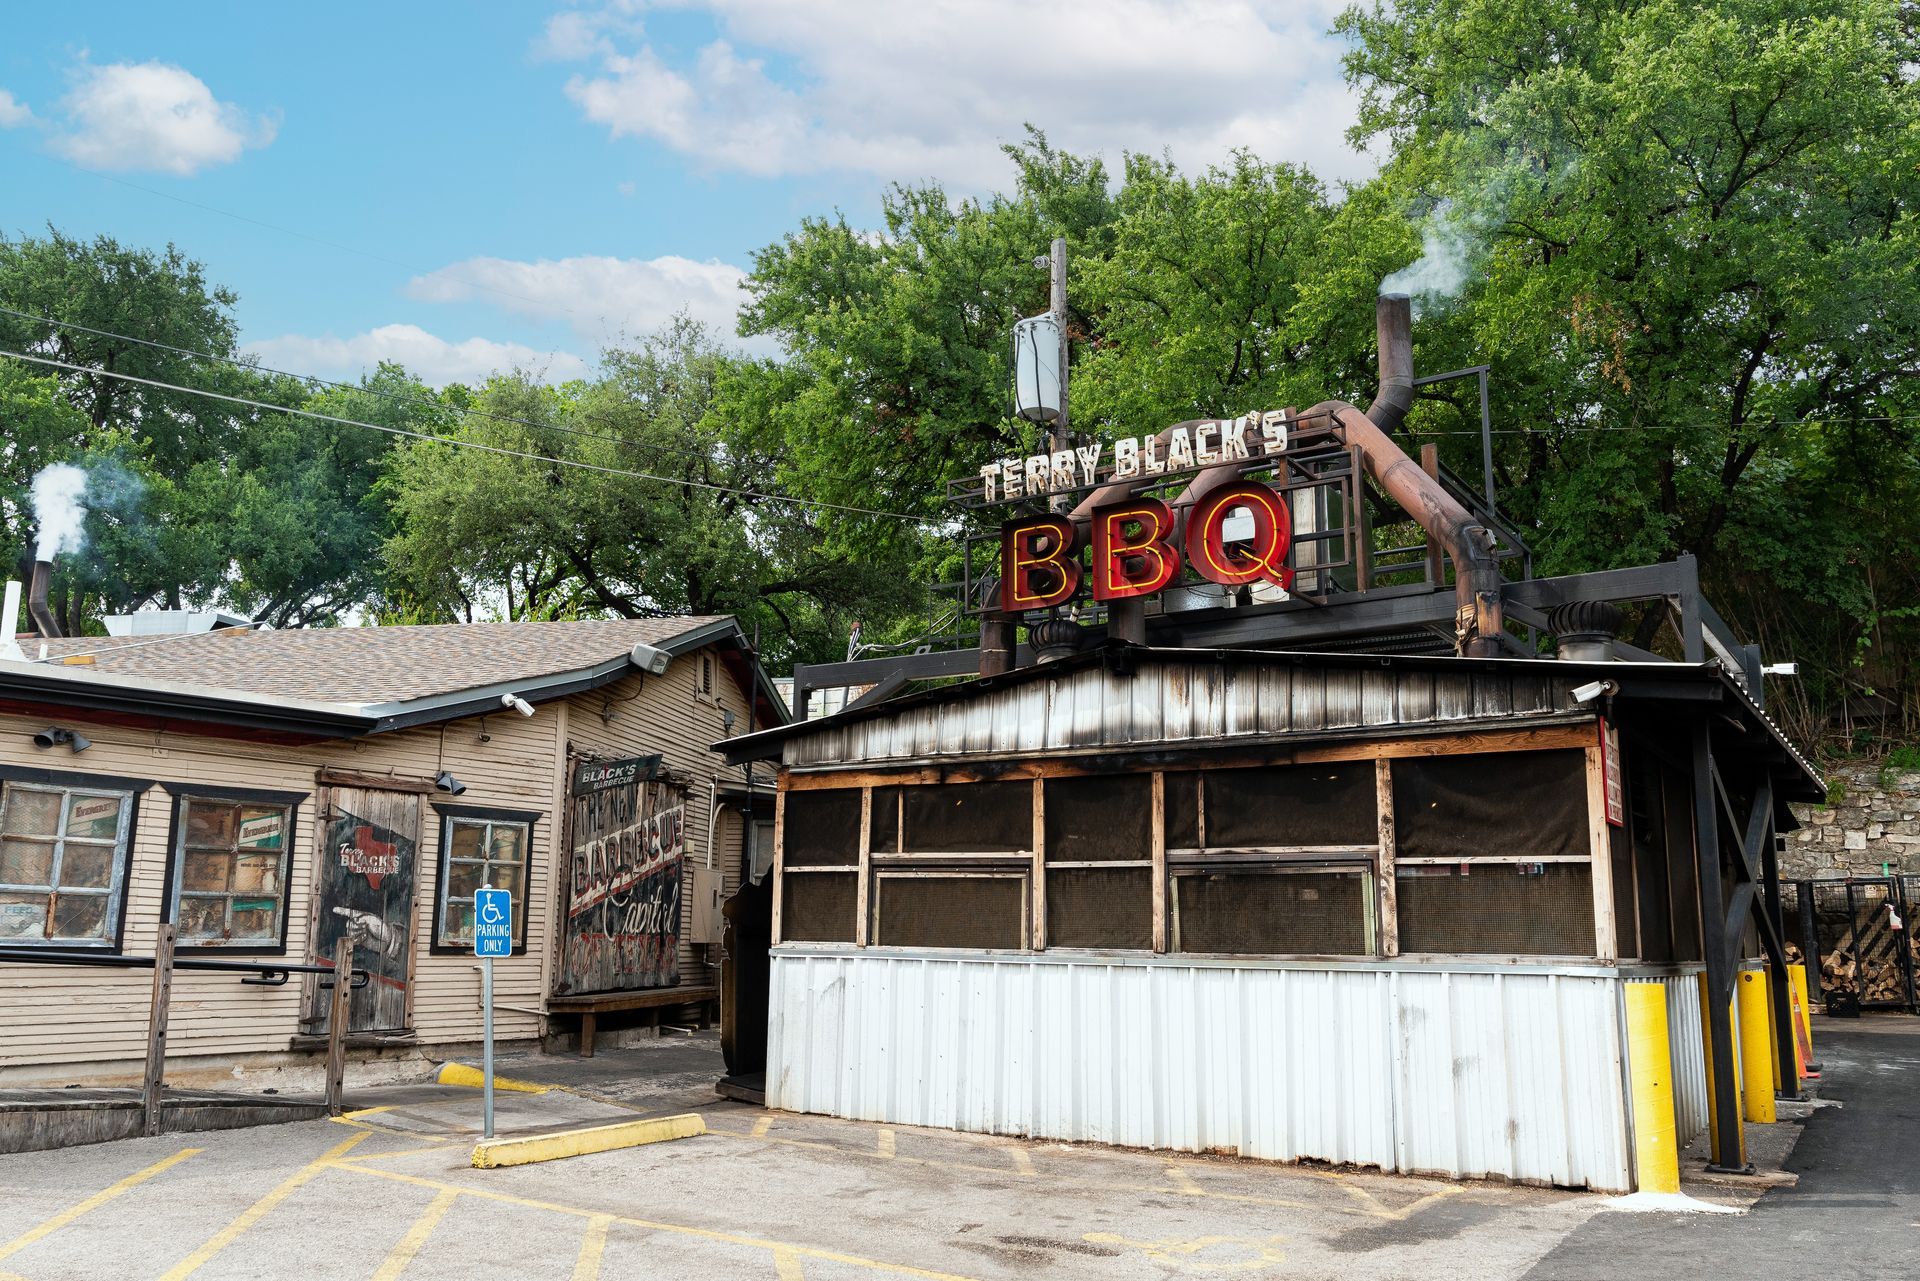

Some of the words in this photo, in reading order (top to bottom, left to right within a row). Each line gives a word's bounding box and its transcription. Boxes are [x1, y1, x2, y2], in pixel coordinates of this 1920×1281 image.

[980, 444, 1102, 501] TERRY
[1114, 409, 1288, 480] BLACK'S
[1001, 480, 1295, 612] BBQ
[582, 764, 637, 784] BLACK'S
[593, 775, 635, 790] BARBECUE
[340, 854, 400, 867] BLACK'S
[574, 808, 682, 899] BARBECUE
[356, 865, 399, 875] BARBECUE
[477, 924, 510, 937] PARKING
[484, 939, 504, 953] ONLY
